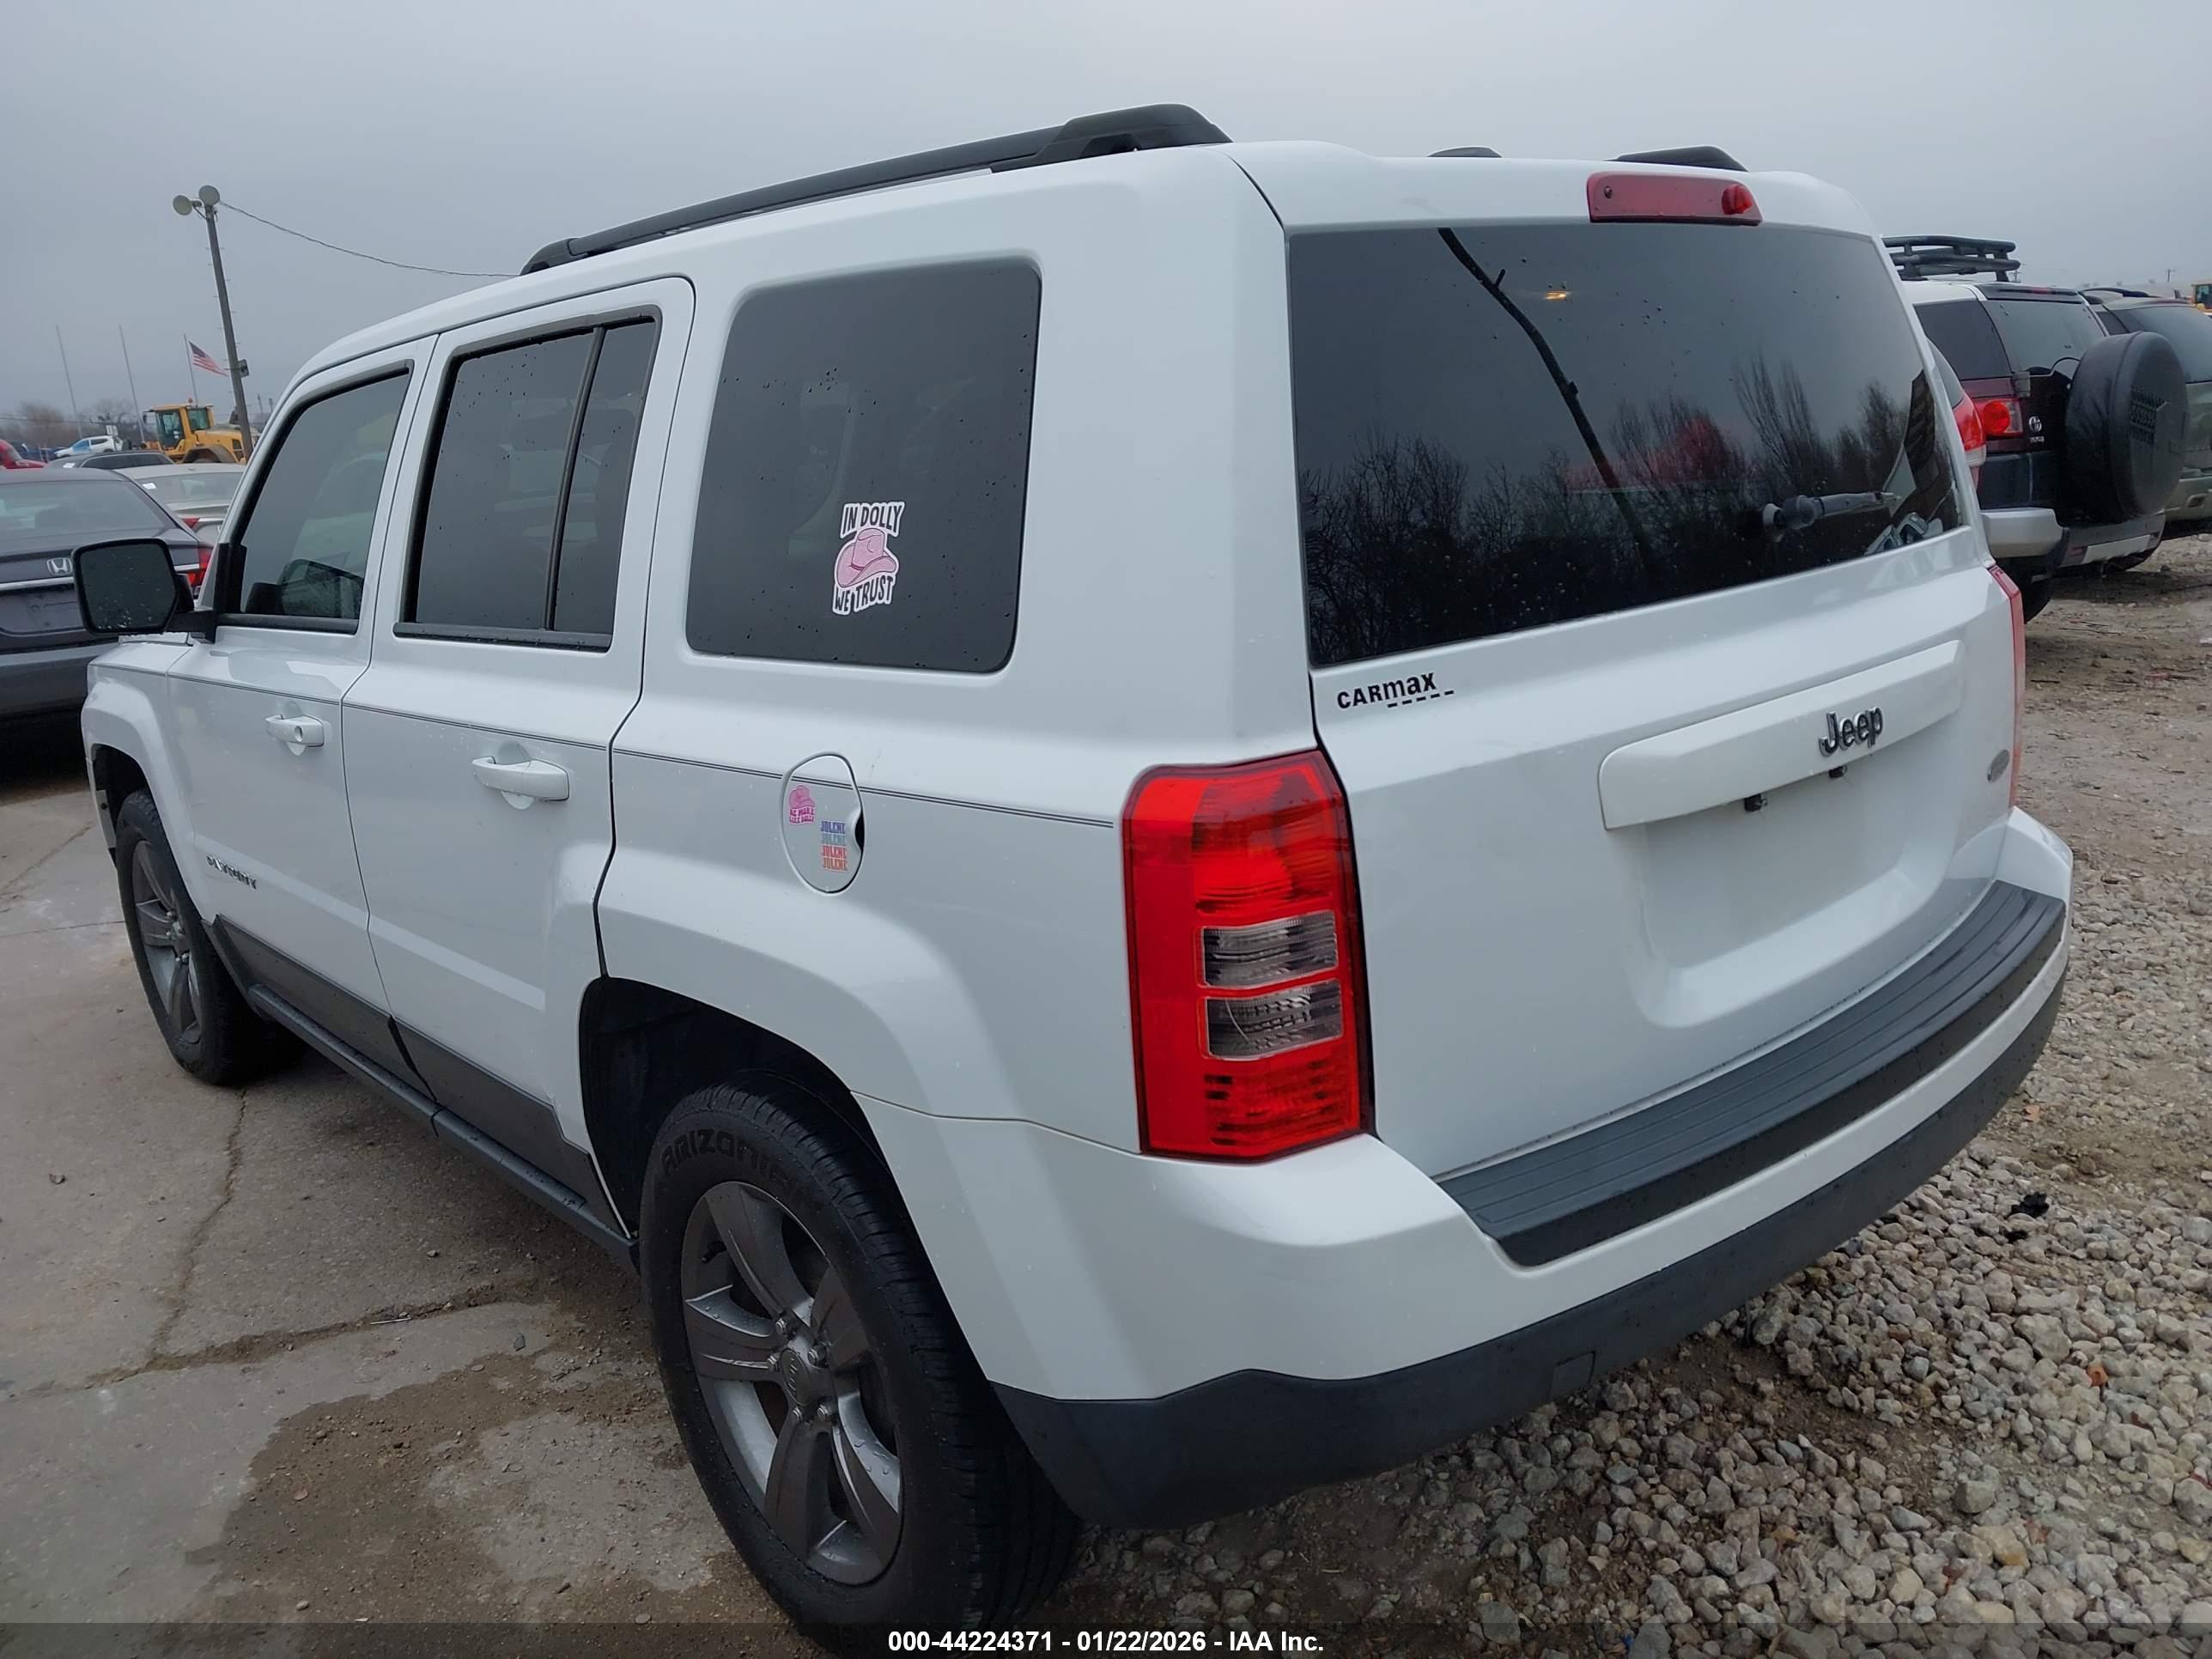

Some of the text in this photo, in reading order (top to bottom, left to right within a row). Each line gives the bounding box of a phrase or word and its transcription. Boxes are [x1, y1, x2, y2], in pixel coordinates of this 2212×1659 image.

[842, 505, 903, 534] IN DOLLY
[834, 574, 894, 612] WE TRUST
[1819, 706, 1884, 757] Jeep
